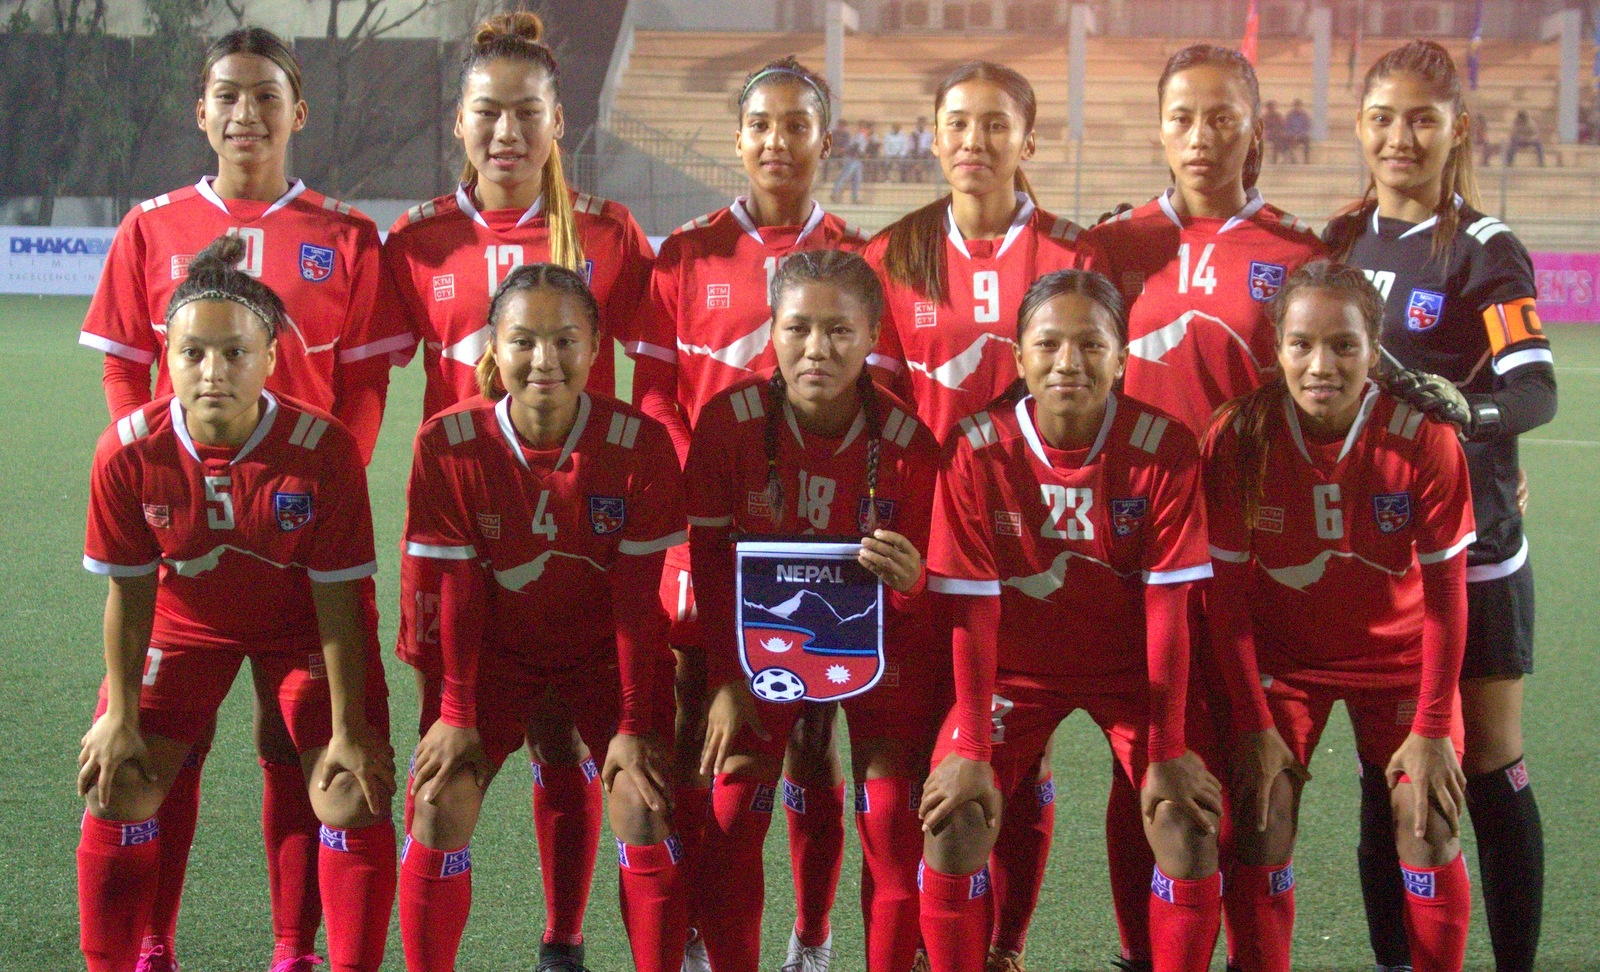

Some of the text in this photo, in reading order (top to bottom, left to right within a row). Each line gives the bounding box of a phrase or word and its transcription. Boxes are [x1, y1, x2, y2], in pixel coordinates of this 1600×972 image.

[226, 226, 264, 278] 0
[1177, 243, 1217, 295] 14
[434, 277, 452, 287] KTM
[436, 289, 452, 299] CTY
[709, 287, 728, 295] KTM
[709, 299, 727, 307] CTY
[763, 256, 790, 307] 1
[973, 270, 1000, 323] 9
[916, 304, 934, 312] KTM
[917, 316, 934, 324] CTY
[205, 475, 236, 529] 5
[531, 490, 559, 541] 4
[797, 469, 837, 530] 18
[1040, 483, 1095, 540] 23
[1313, 483, 1345, 539] 6
[677, 569, 699, 622] 1
[776, 564, 844, 583] NEPAL
